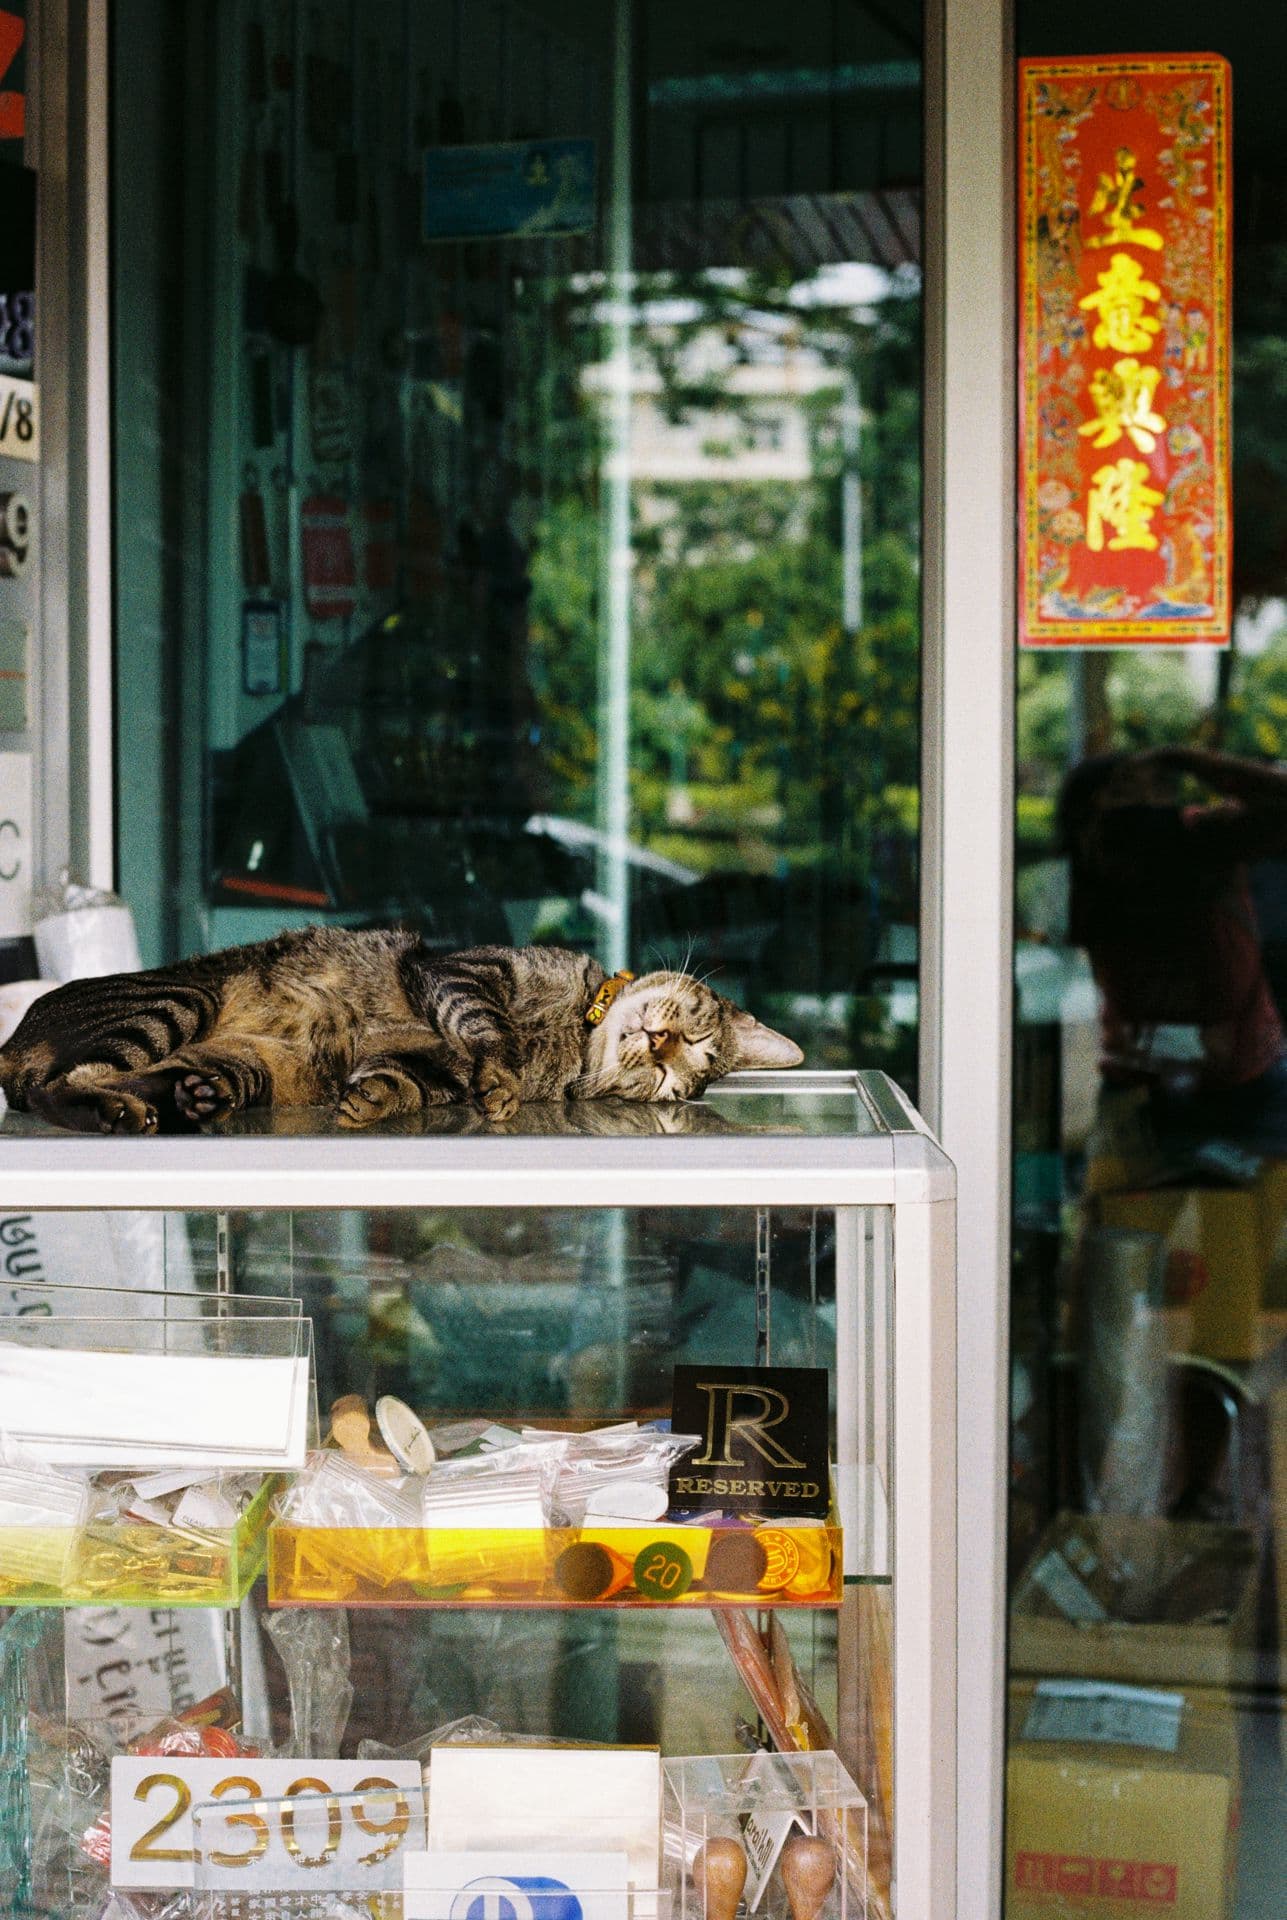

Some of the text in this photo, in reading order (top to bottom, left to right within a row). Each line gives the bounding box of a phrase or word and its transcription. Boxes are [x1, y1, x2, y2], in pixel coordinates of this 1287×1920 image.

[692, 1383, 807, 1468] R
[676, 1477, 821, 1498] RESERVED
[643, 1554, 682, 1590] 20
[129, 1773, 410, 1869] 2309
